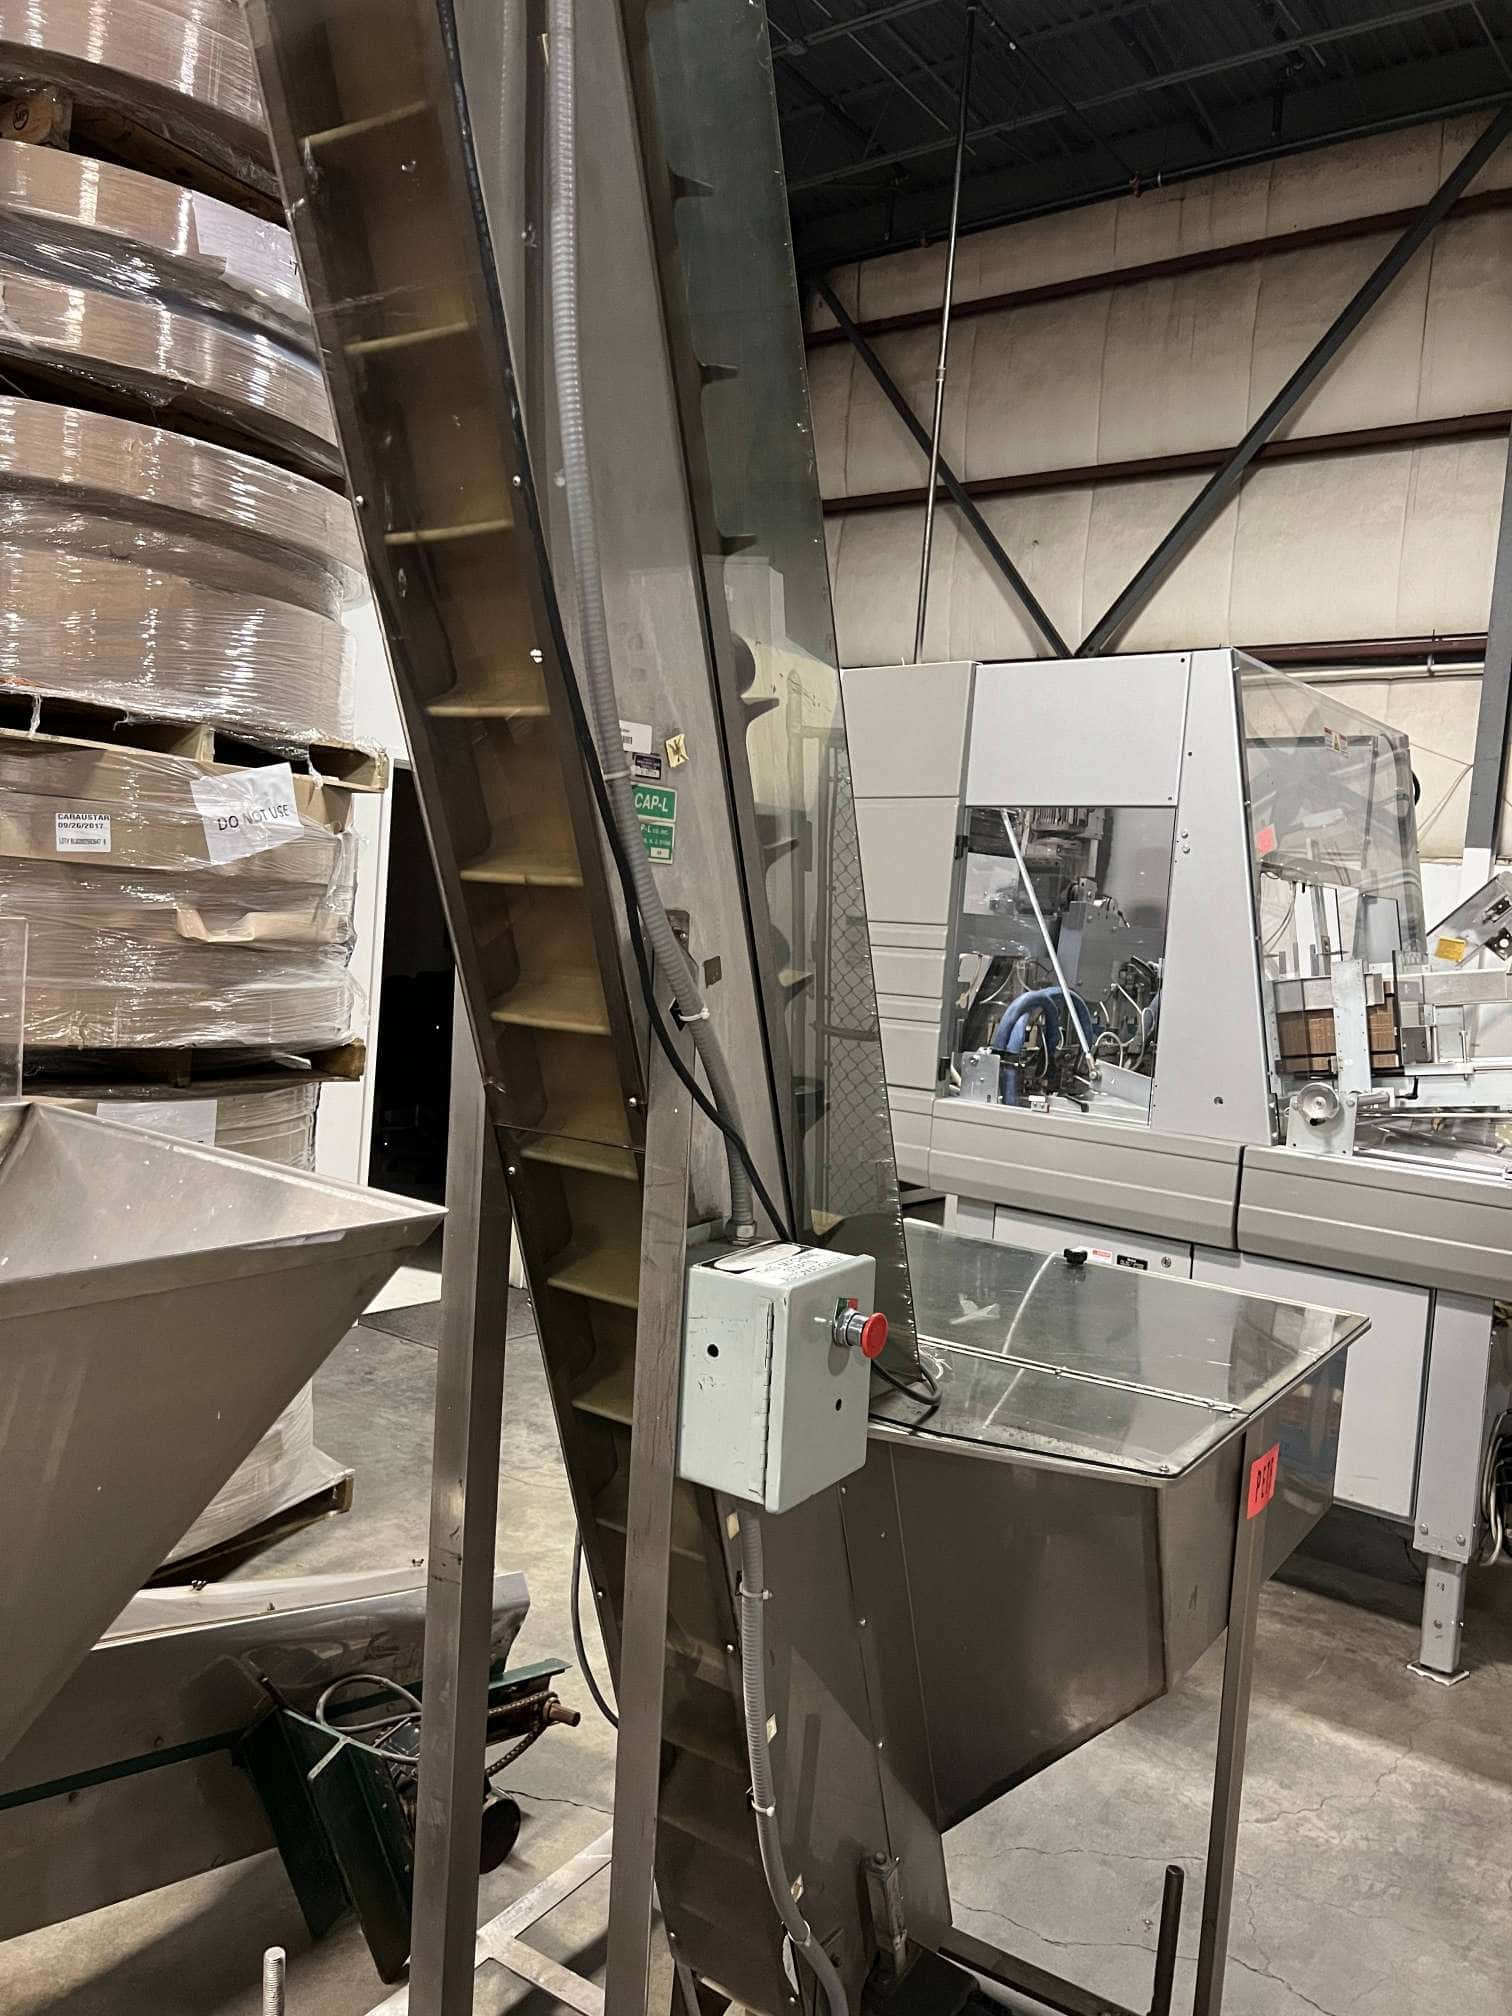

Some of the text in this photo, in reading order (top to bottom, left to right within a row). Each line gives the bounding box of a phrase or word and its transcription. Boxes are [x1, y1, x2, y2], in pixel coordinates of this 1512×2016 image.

[634, 793, 669, 812] CAP-L
[217, 804, 289, 830] DO NOT USE
